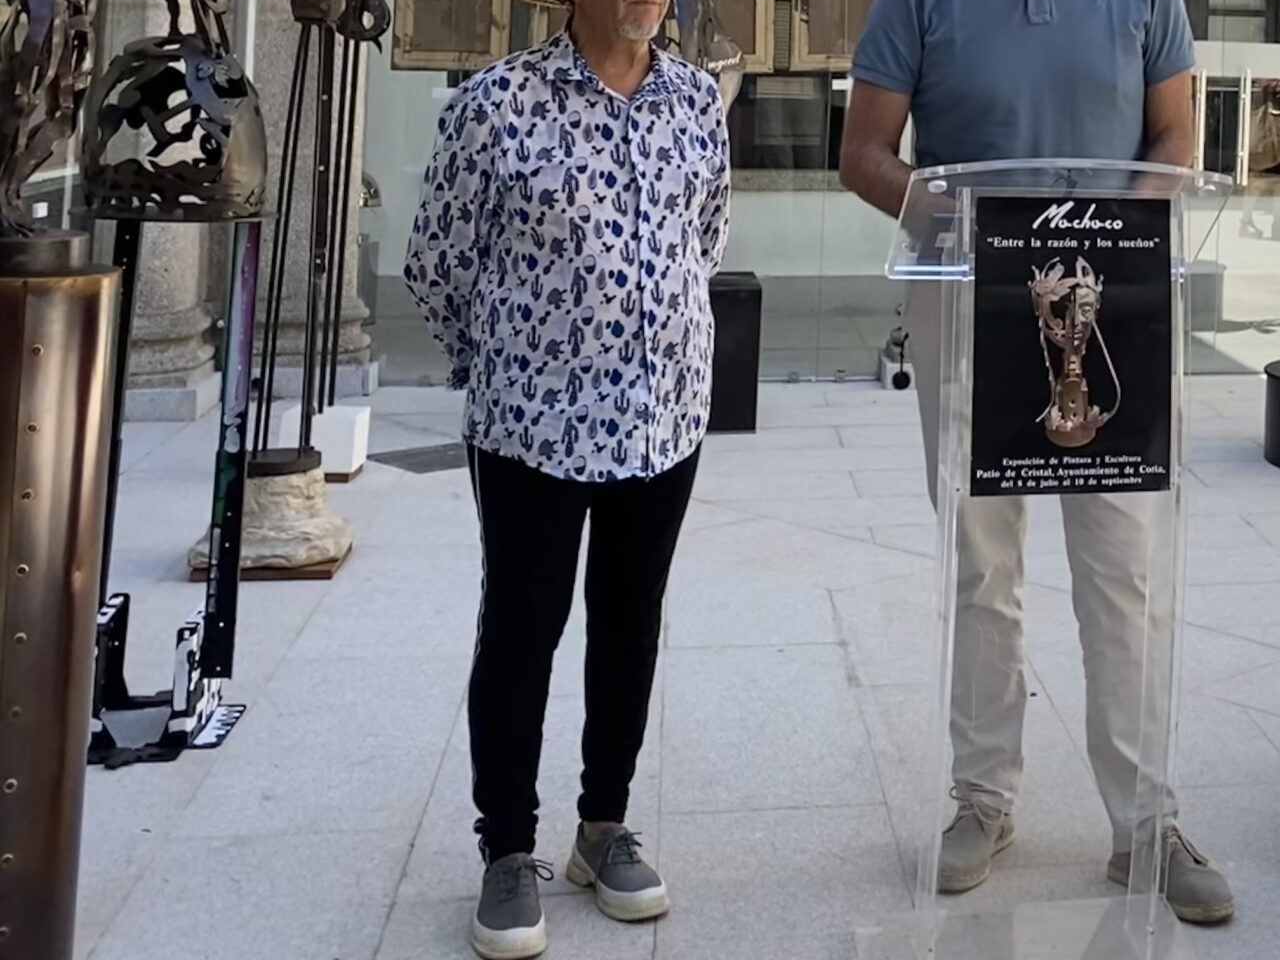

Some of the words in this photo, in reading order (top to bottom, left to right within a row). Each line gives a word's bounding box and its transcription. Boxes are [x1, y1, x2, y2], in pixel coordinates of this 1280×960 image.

[1031, 237, 1042, 248] la
[1047, 237, 1078, 248] razón
[1084, 240, 1091, 250] y
[1097, 237, 1113, 248] los
[1003, 457, 1045, 467] Exposición
[1049, 457, 1059, 465] de
[1063, 456, 1092, 465] Pintura
[1095, 457, 1101, 465] y
[1104, 455, 1142, 464] Escultura
[976, 469, 1001, 479] Patio
[1005, 468, 1017, 478] de
[1056, 467, 1120, 478] Ayuntamiento
[1123, 465, 1135, 475] de
[1000, 479, 1014, 488] del
[1026, 479, 1036, 487] de
[1039, 478, 1059, 488] julio
[1062, 478, 1071, 487] al
[1075, 477, 1085, 486] 10
[1088, 477, 1098, 486] de
[1101, 476, 1143, 486] septiembre
